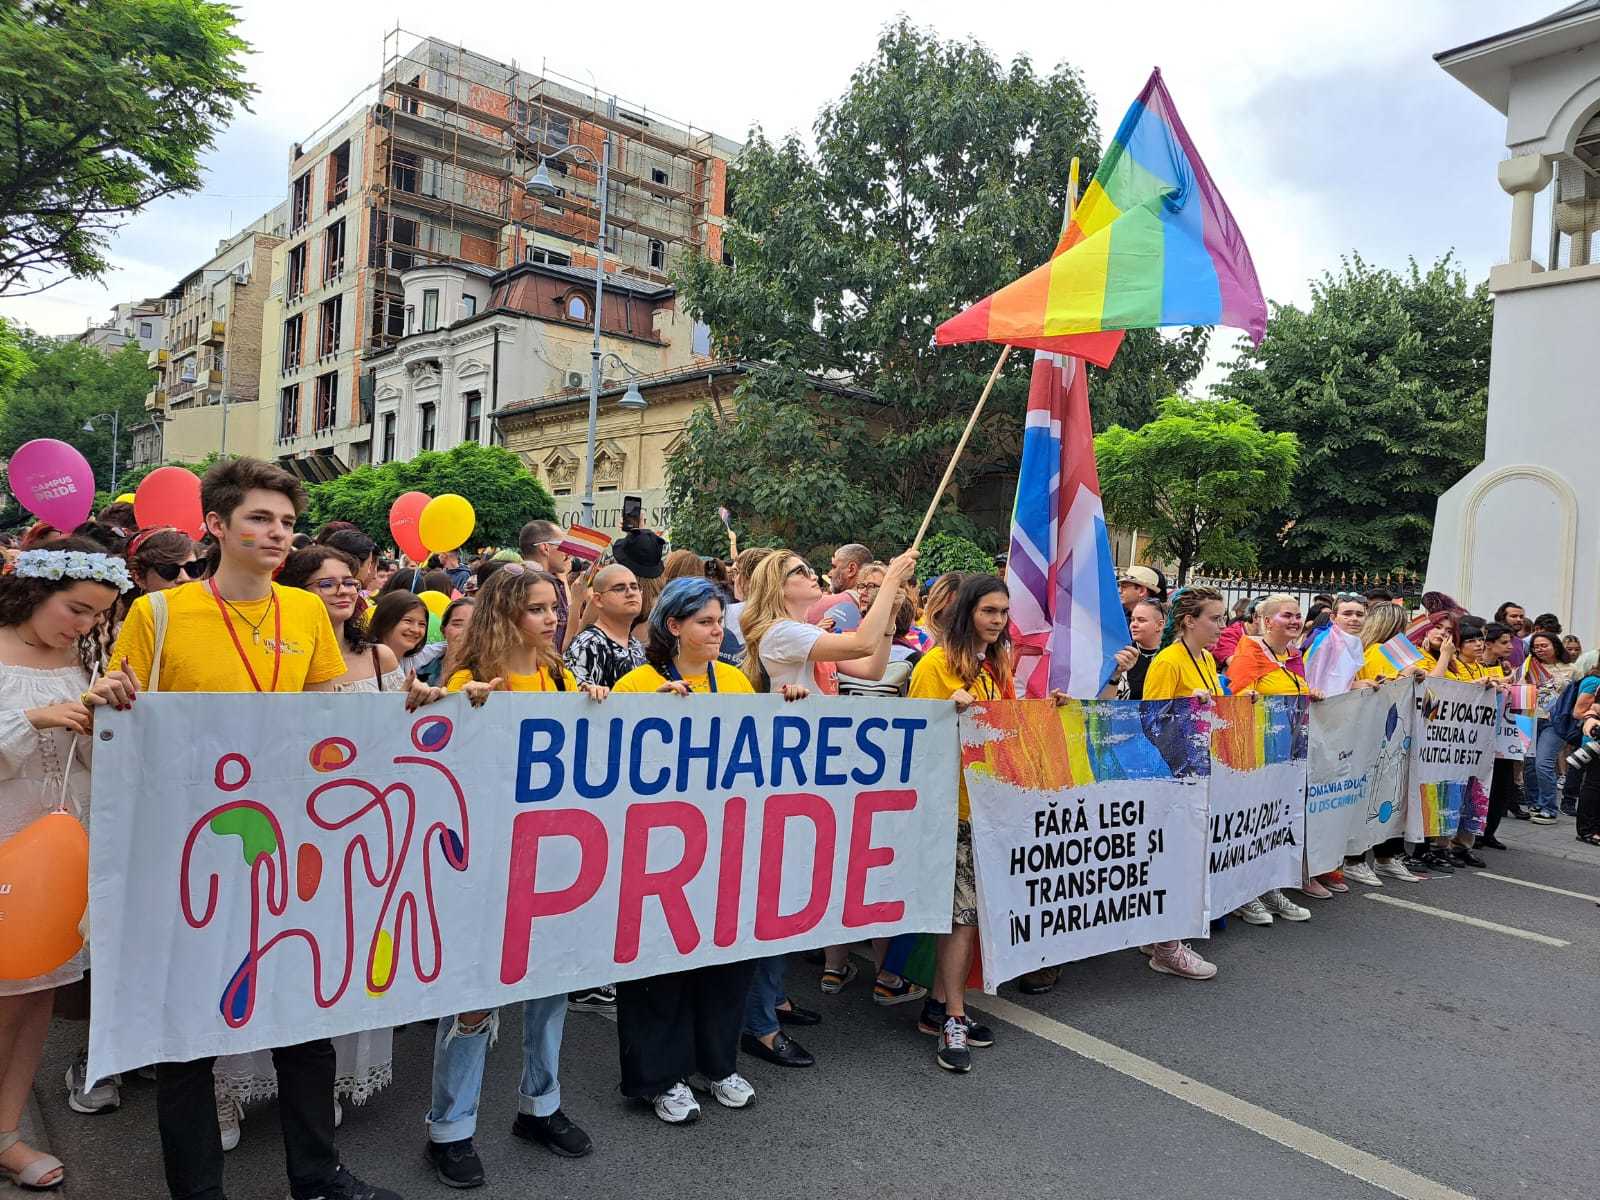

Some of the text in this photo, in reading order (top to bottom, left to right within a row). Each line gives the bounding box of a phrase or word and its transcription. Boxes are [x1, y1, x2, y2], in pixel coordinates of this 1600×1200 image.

[31, 475, 73, 493] CAMPUS
[34, 483, 77, 502] PRIDE
[1426, 724, 1465, 744] CENZURA
[514, 714, 927, 805] BUCHAREST
[1034, 798, 1145, 838] FĂRĂ LEGI
[1209, 812, 1234, 844] LX
[1009, 828, 1164, 876] HOMOFOBE ȘI
[500, 789, 917, 985] PRIDE
[1025, 861, 1150, 908] TRANSFOBE
[1009, 889, 1167, 947] ÎN PARLAMENT
